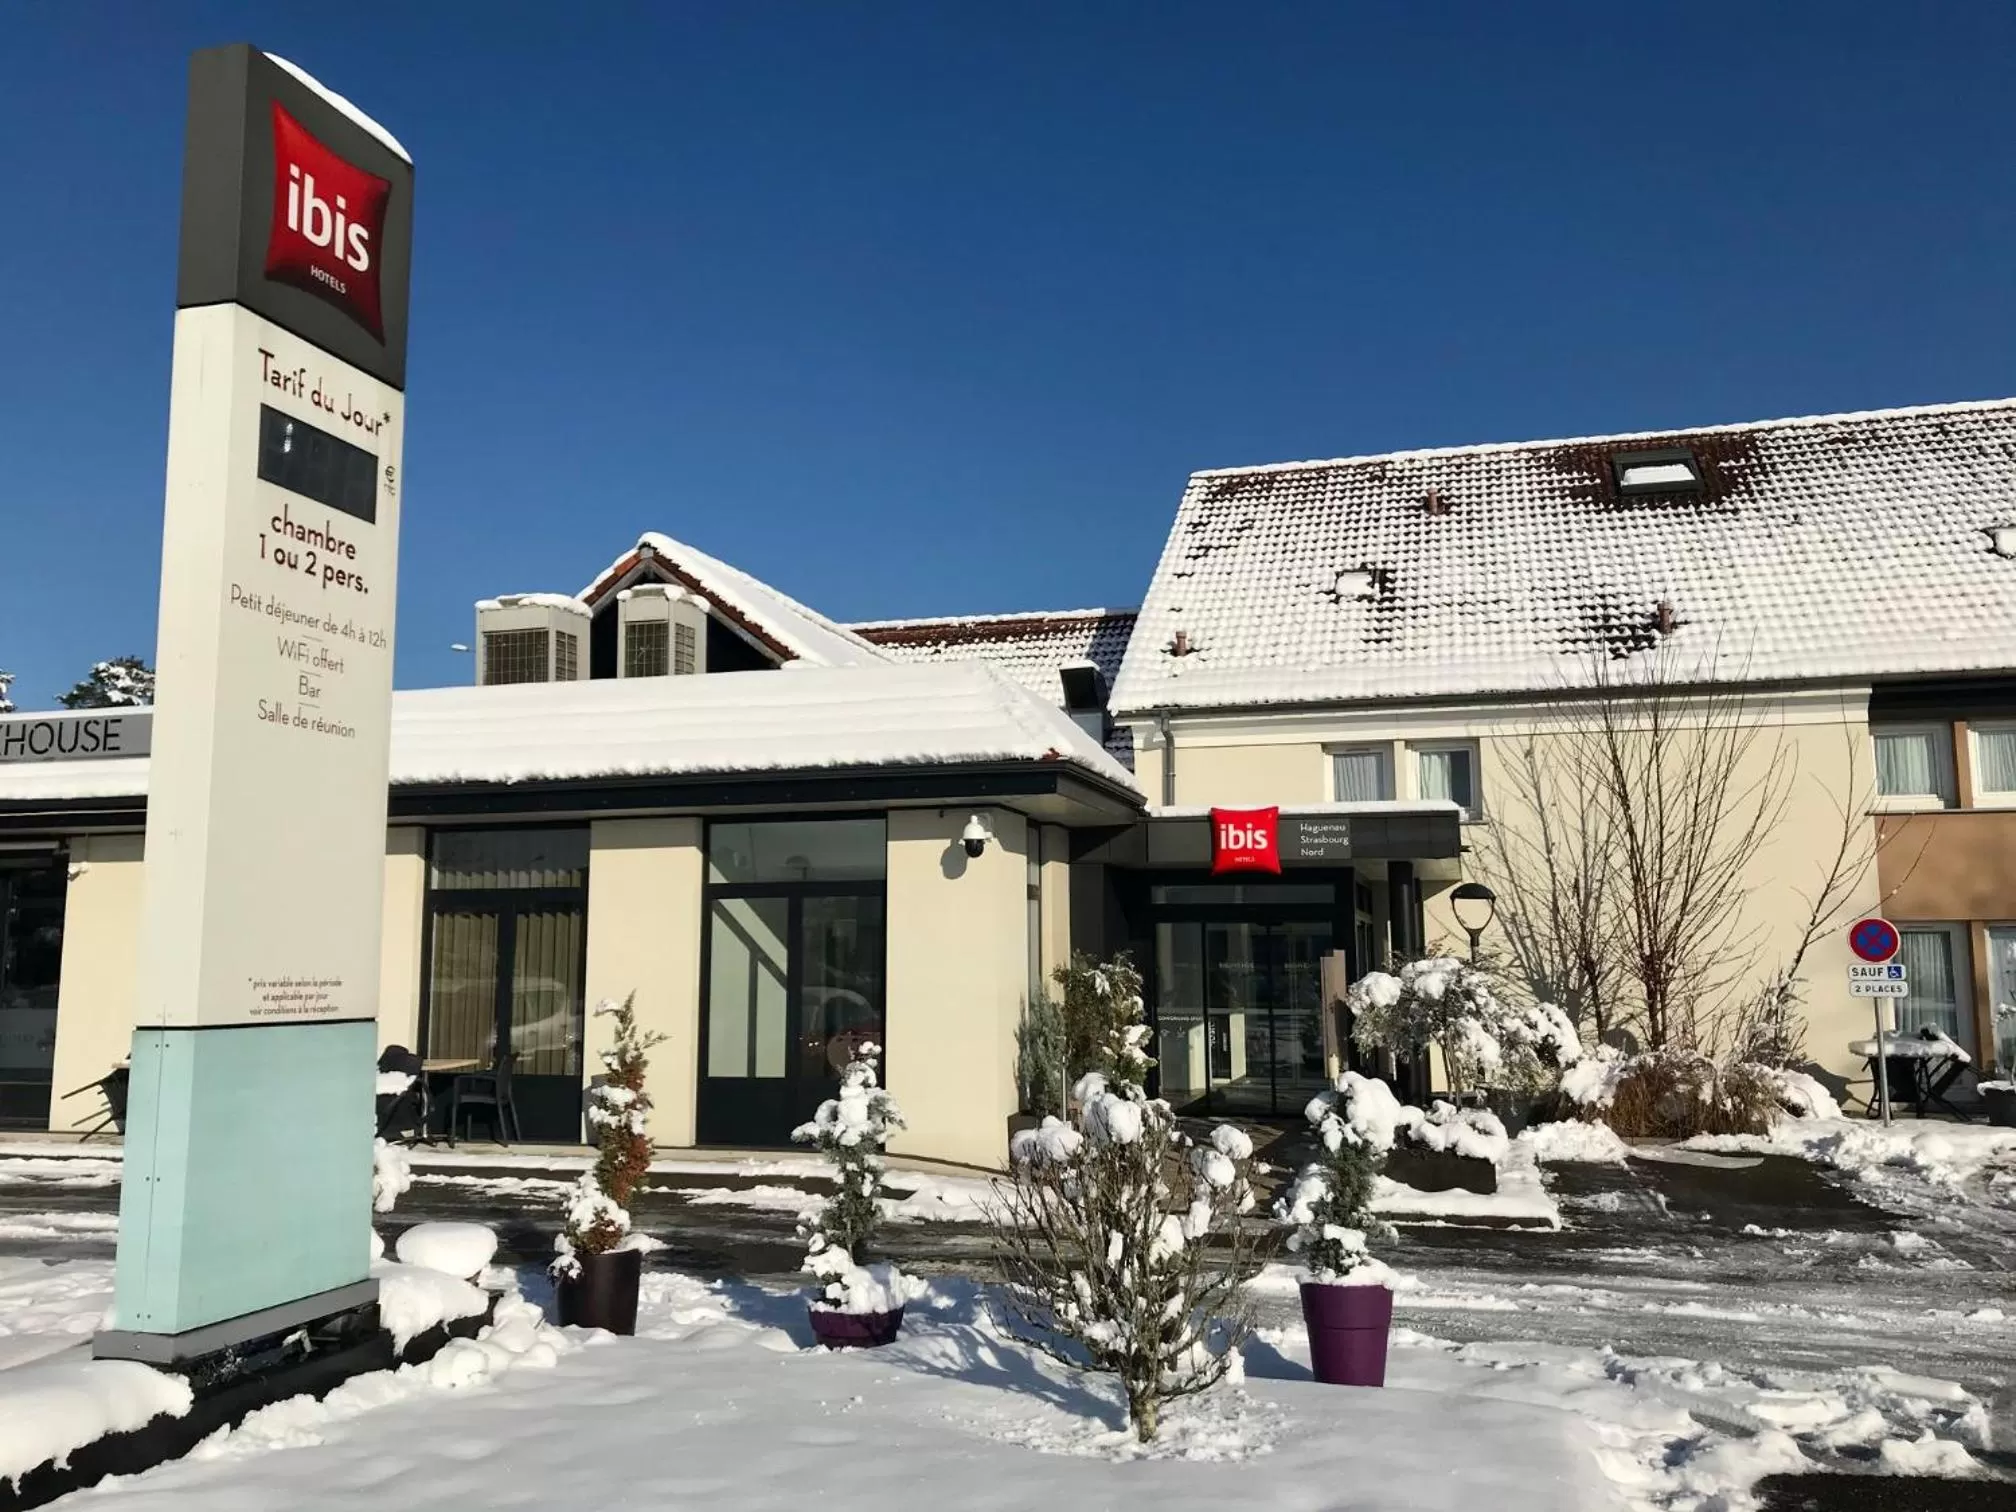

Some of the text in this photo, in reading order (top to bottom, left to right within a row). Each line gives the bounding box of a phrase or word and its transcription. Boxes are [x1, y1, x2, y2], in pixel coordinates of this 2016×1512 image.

[287, 163, 369, 272] ibis
[310, 264, 347, 294] HOTELS
[258, 347, 306, 398] Tarif
[311, 376, 334, 413] du
[271, 503, 356, 560] chambre
[259, 533, 369, 594] 1 ou 2 pers.
[230, 583, 387, 649] Petit déjeuner de 4h à 12h
[277, 635, 345, 674] WiFi offert
[298, 675, 321, 699] Bar
[257, 698, 356, 739] Salle de réunion
[0, 718, 123, 756] HOUSE
[1220, 822, 1269, 850] ibis
[1300, 823, 1346, 834] Haguenau
[1300, 835, 1349, 846] Strasbourg
[1300, 847, 1324, 856] Nord
[1851, 967, 1884, 977] SAUF
[1855, 985, 1903, 993] 2 PLACES
